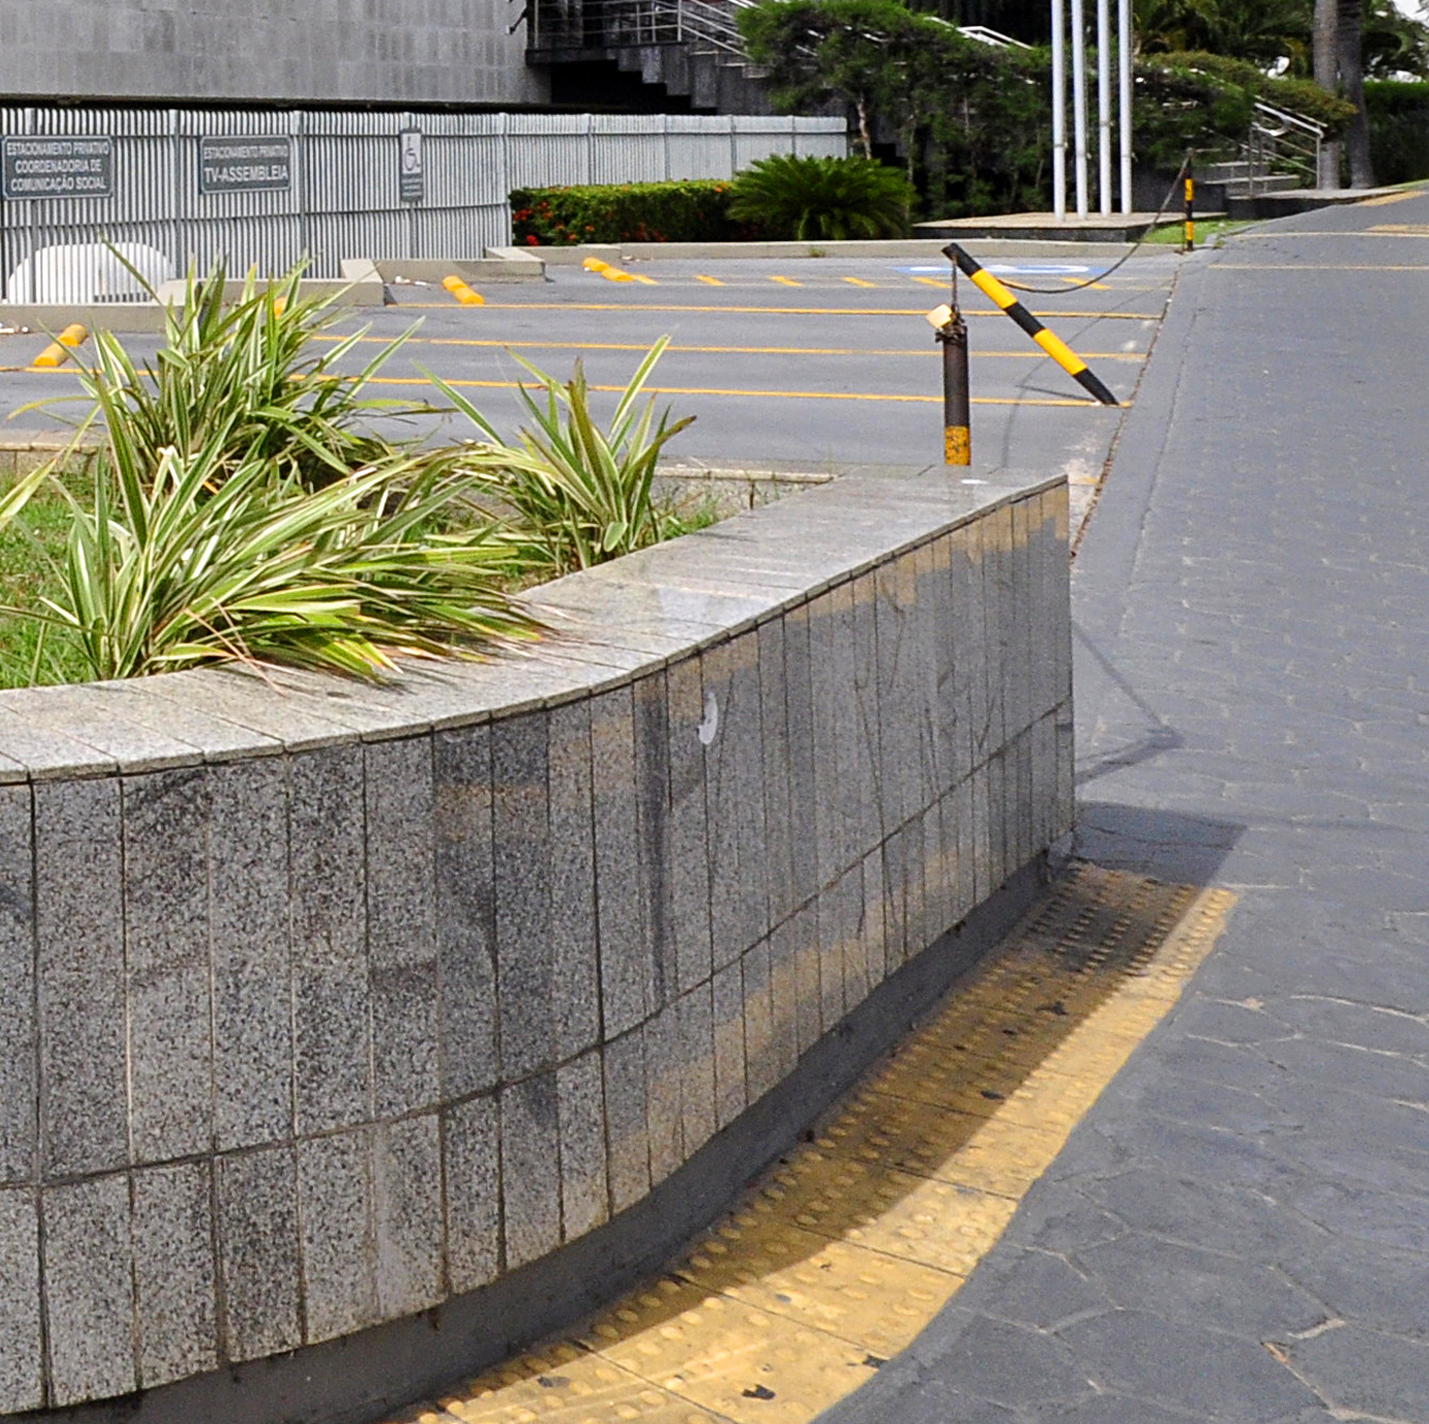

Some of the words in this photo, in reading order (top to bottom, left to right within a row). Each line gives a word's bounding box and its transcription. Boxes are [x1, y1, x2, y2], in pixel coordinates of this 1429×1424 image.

[6, 142, 72, 156] ESTACIONAMENTO
[73, 141, 110, 155] PRIVATIVO
[15, 159, 89, 173] COORDENADORIA
[89, 158, 103, 172] DE
[11, 175, 74, 193] COMUNICAÇÃO
[75, 176, 108, 190] SOCIAL
